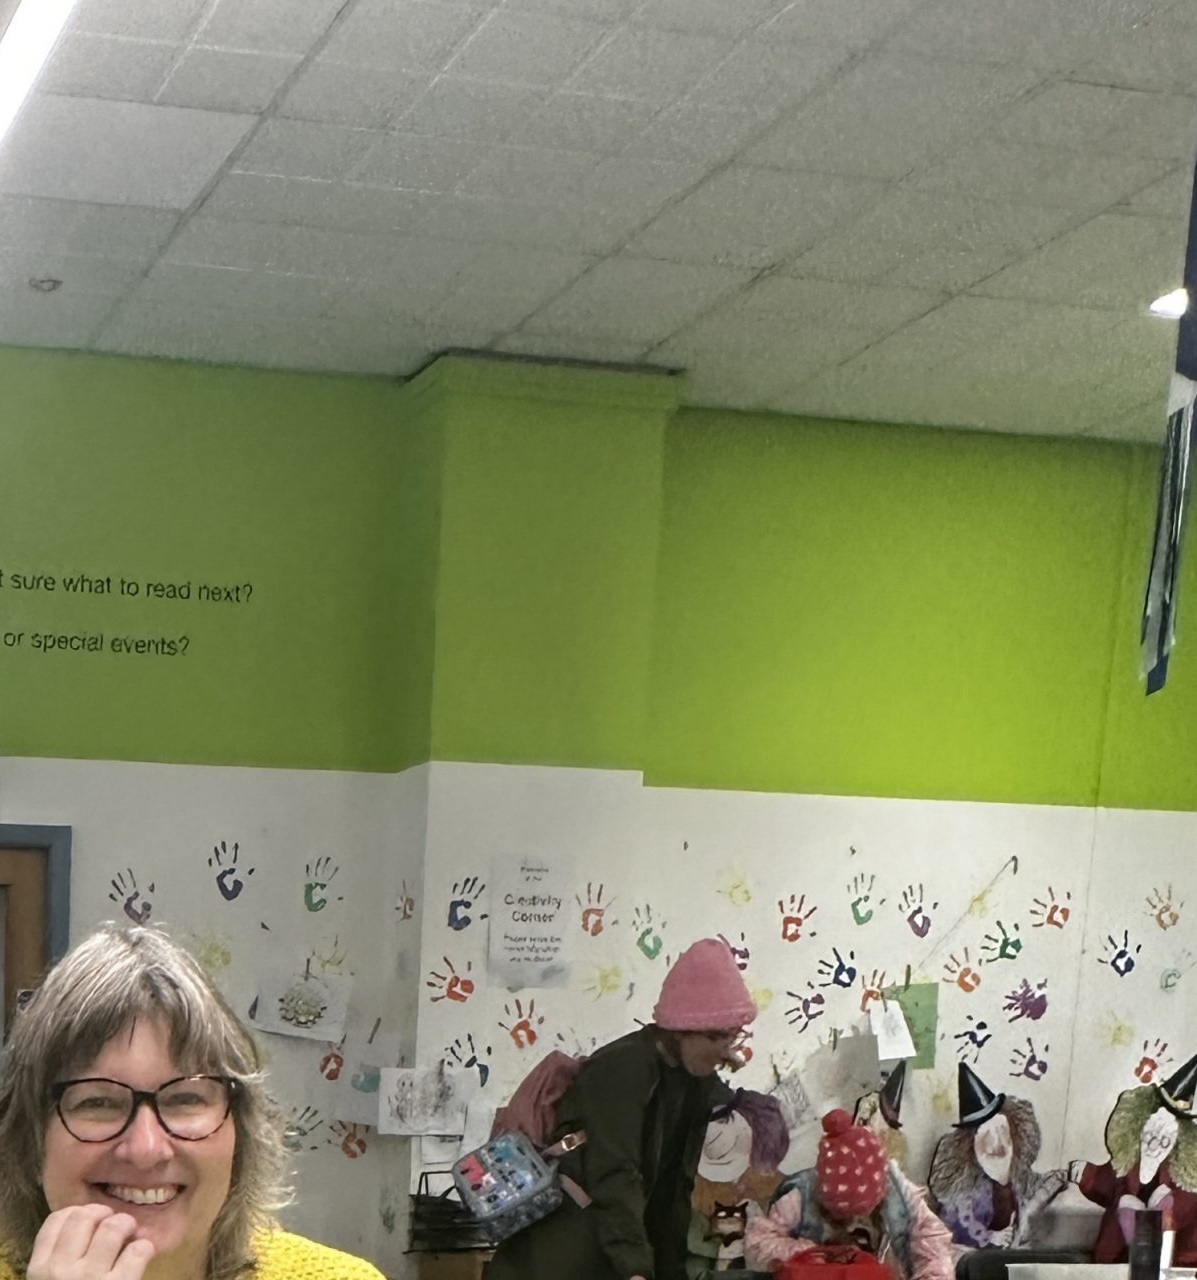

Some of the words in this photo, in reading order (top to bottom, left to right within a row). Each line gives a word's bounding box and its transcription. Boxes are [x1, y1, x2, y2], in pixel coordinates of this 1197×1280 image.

[10, 573, 56, 592] sure
[62, 576, 112, 595] what
[120, 577, 140, 597] to
[146, 580, 191, 600] read
[198, 583, 253, 603] next?
[3, 631, 24, 647] or
[30, 631, 104, 652] special
[110, 636, 191, 657] events?
